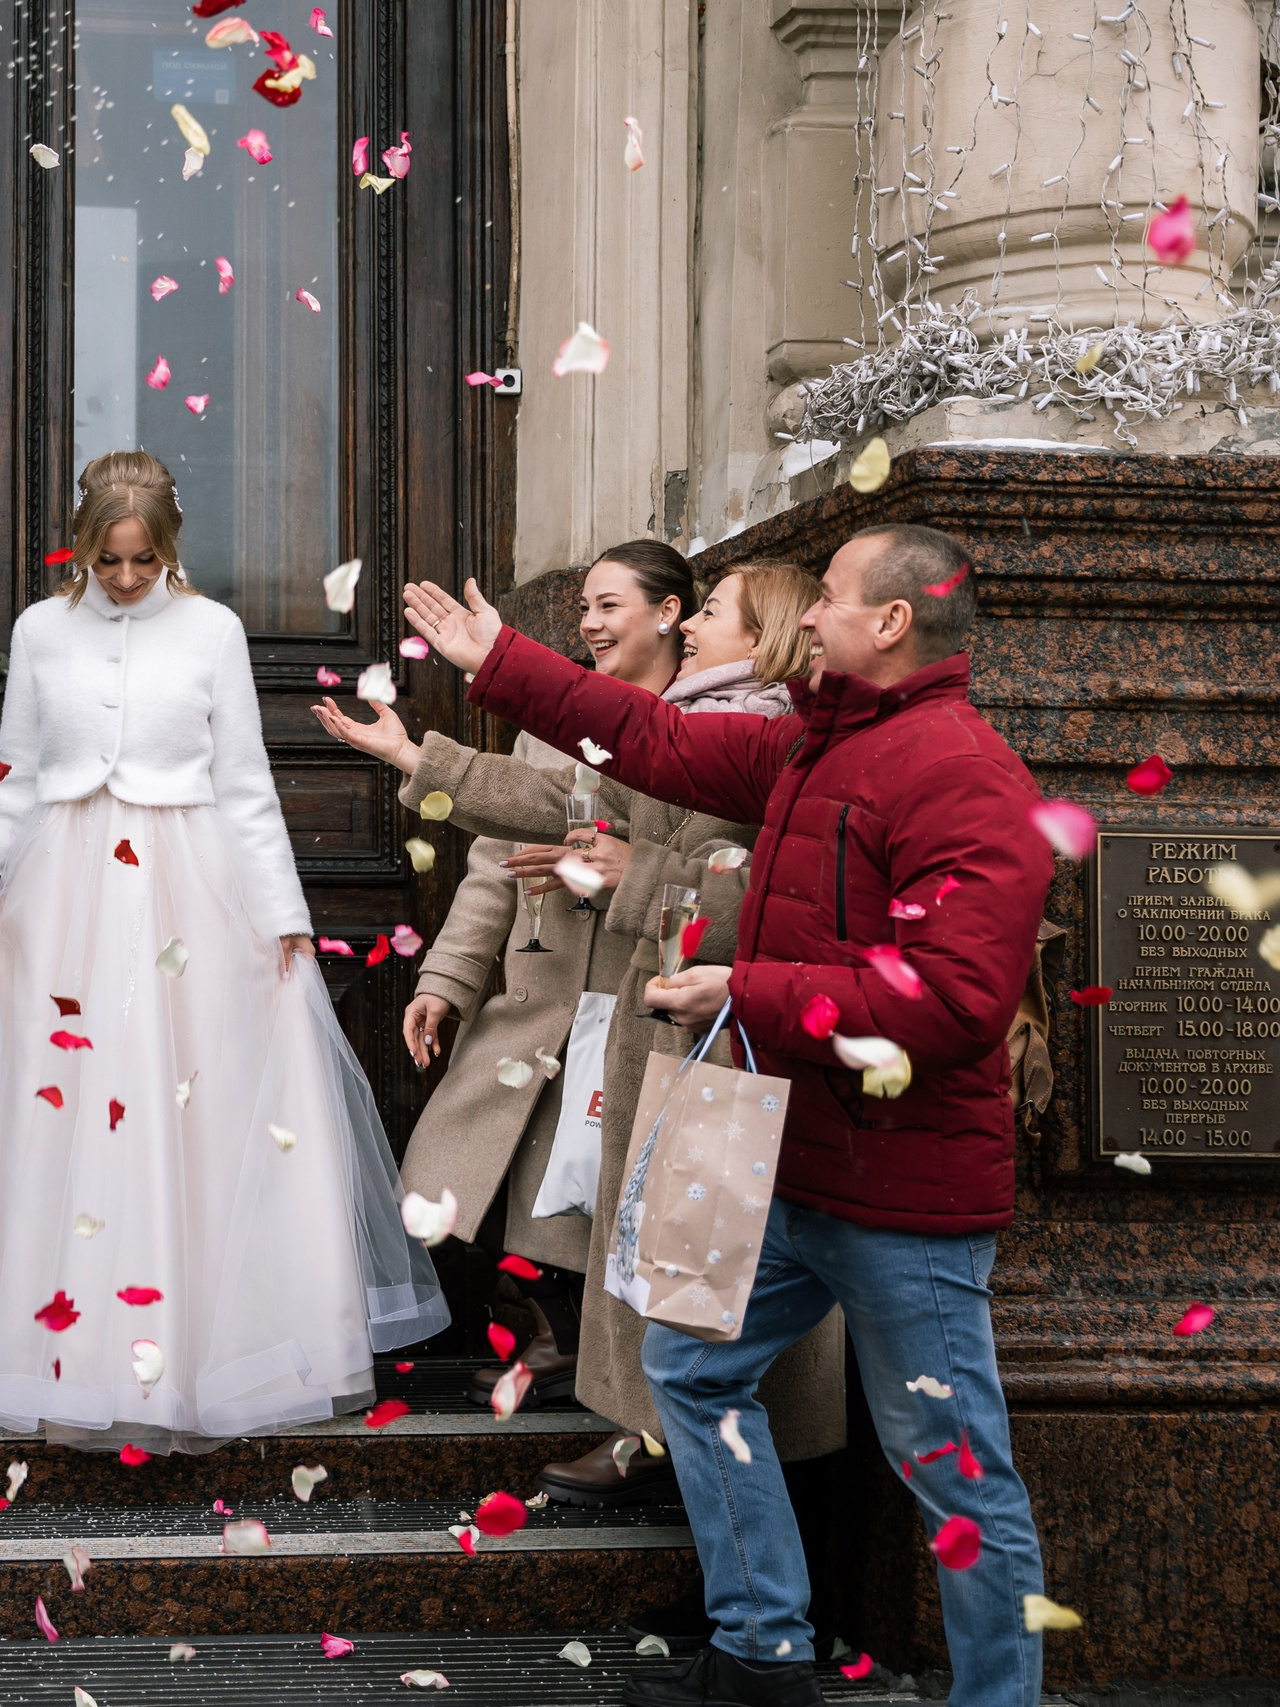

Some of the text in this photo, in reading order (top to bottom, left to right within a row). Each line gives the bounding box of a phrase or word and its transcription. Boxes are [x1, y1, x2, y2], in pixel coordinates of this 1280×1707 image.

[1151, 842, 1237, 860] РЕЖИМ
[1148, 867, 1239, 884] РАБОТ
[1128, 895, 1260, 907] ПРИЕМ ЗАЯВЛЕ
[1118, 908, 1271, 921] О ЗАКЛЮЧЕНИИ БРАКА
[1140, 946, 1248, 958] БЕЗ ВЫХОДНЫХ
[1135, 966, 1254, 979] ПРИЕМ ГРАЖДАН
[1118, 979, 1272, 992] НАЧАЛЬНИКОМ ОТДЕЛА
[1109, 1001, 1168, 1012] ВТОРНИК
[1109, 1026, 1165, 1036] ЧЕТВЕРГ
[1125, 1049, 1266, 1061] ВЫДАЧА ПОВТОРНЫХ
[1118, 1062, 1274, 1074] ДОКУМЕНТОВ В АРХИВЕ
[1142, 1099, 1249, 1111] БЕЗ ВЫХОДНЫХ
[1166, 1113, 1226, 1124] ПЕРЕРЫВ
